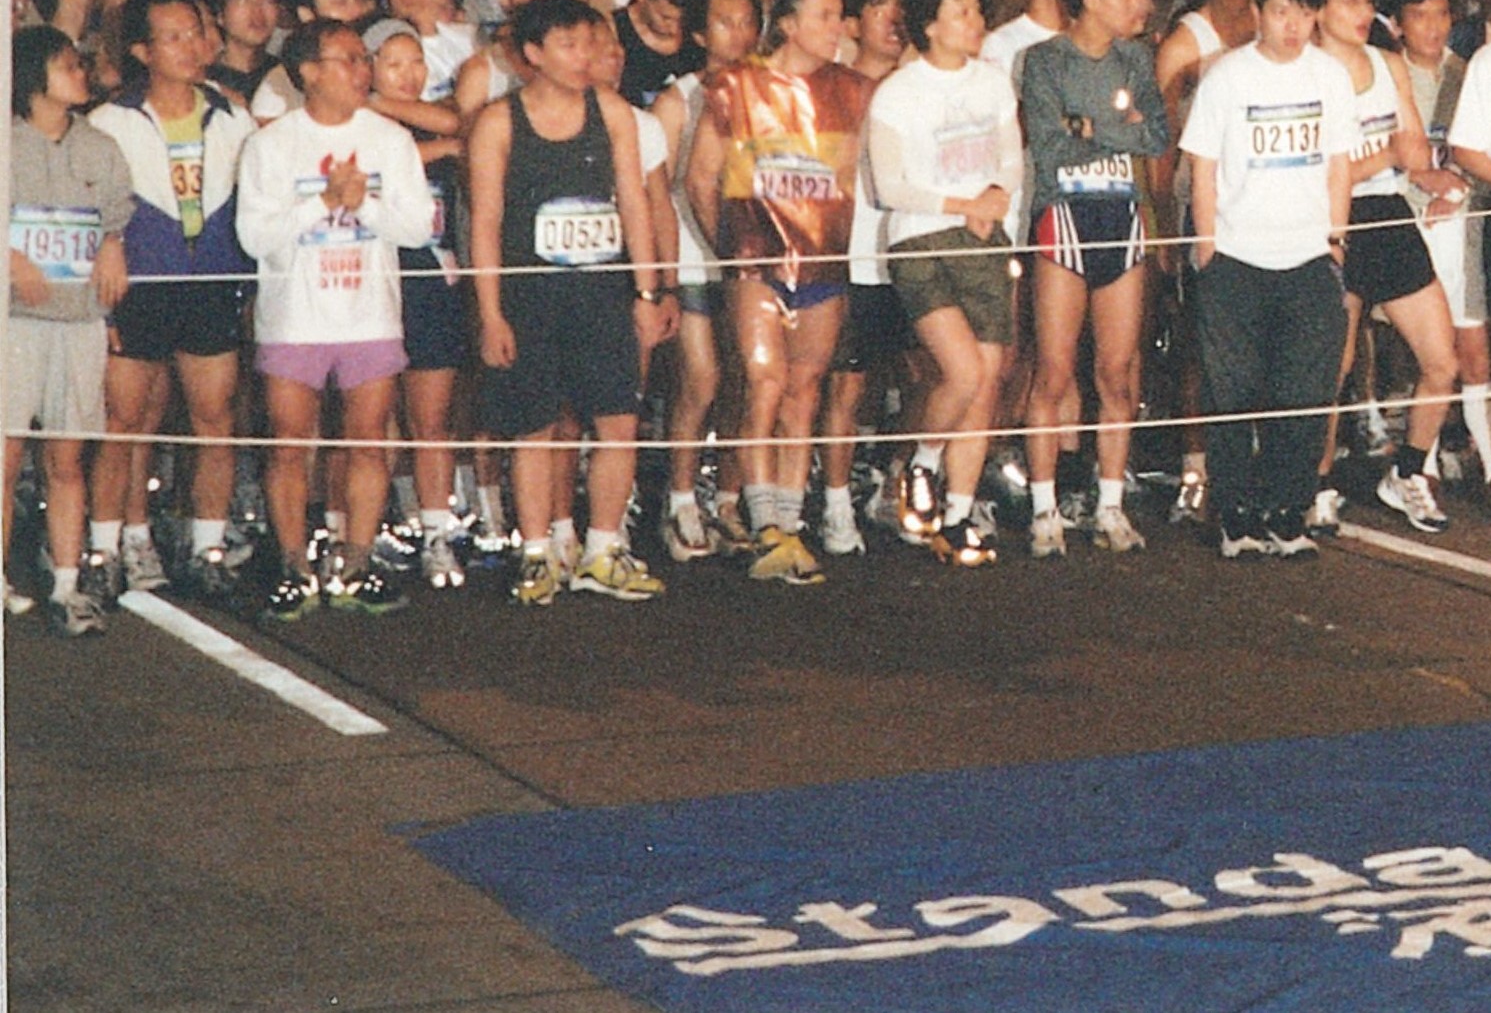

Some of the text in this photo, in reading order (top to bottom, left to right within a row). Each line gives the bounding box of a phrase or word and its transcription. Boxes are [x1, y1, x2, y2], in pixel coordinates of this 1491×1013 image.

[1252, 121, 1320, 155] 02131
[22, 227, 99, 262] 19518
[543, 217, 617, 250] 00524
